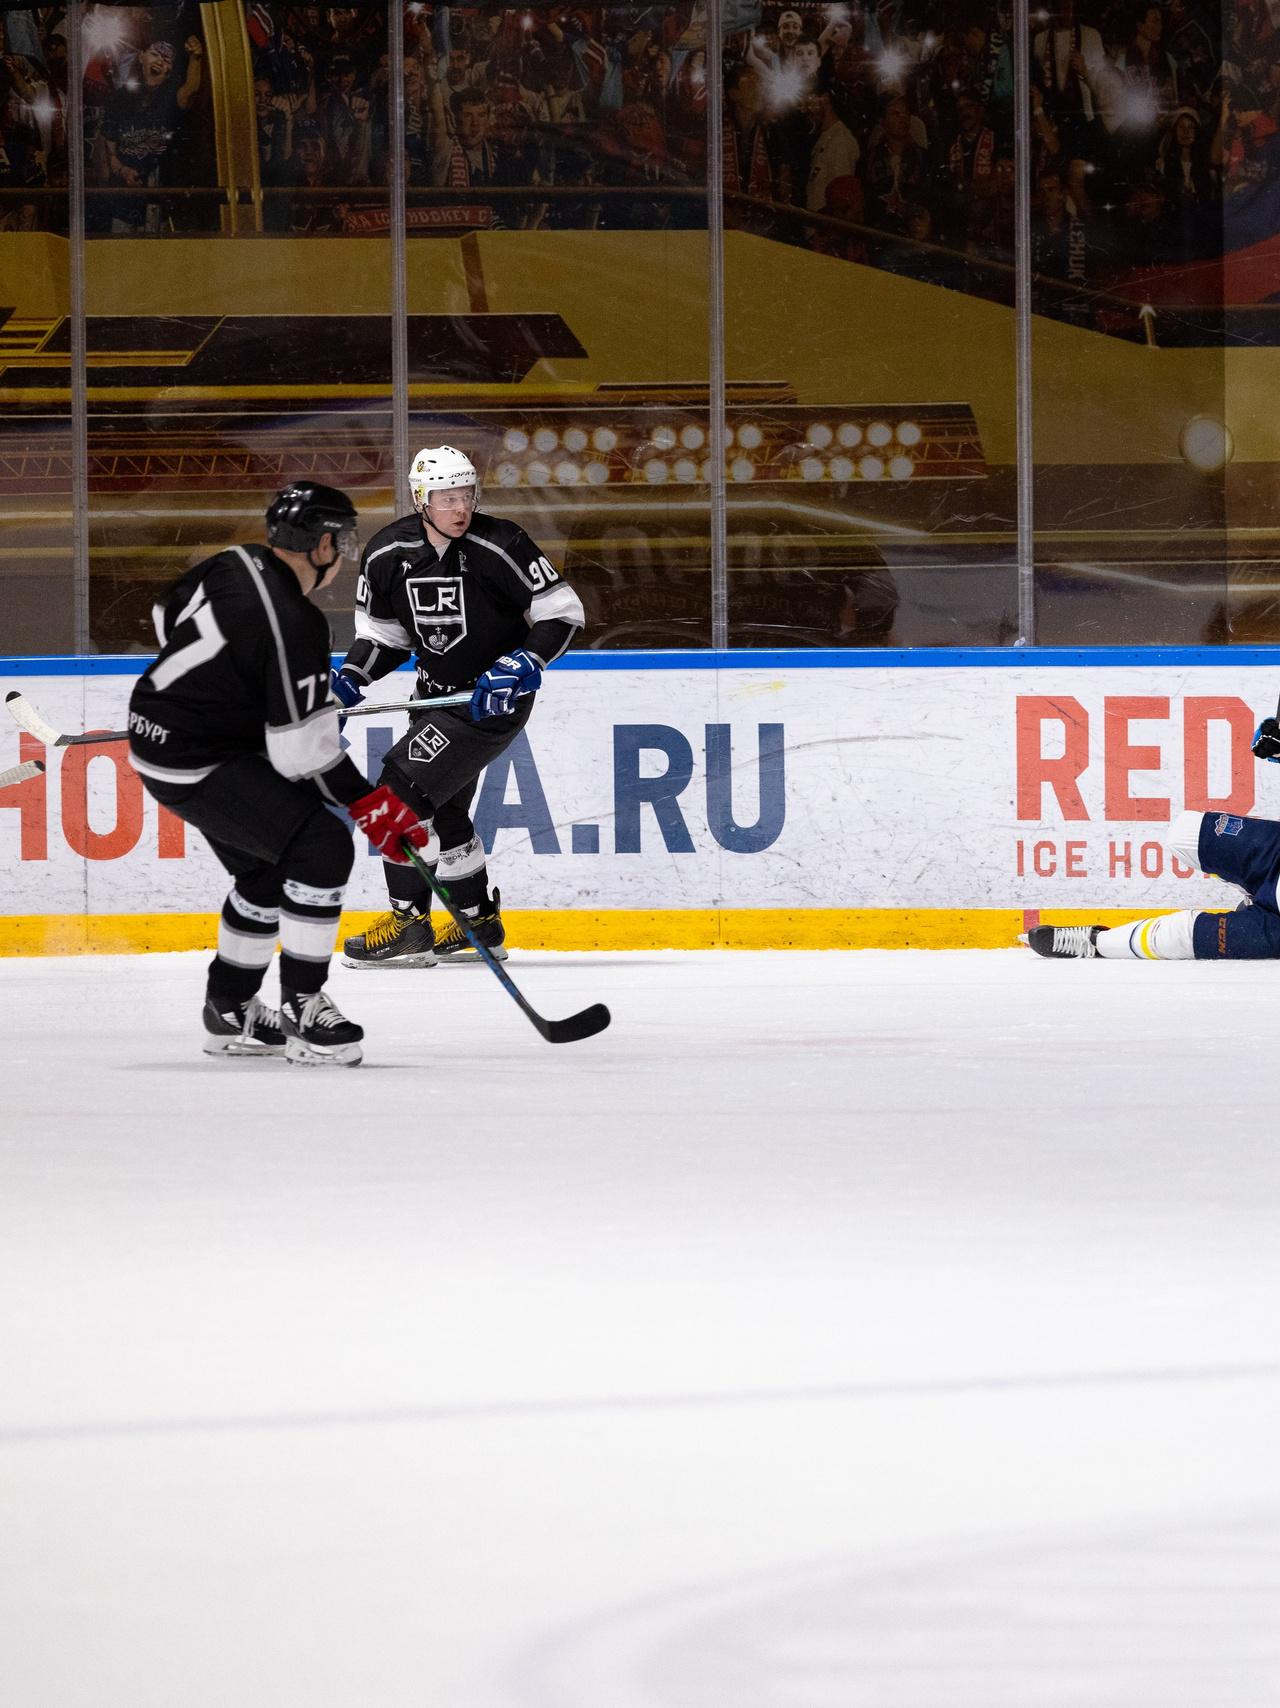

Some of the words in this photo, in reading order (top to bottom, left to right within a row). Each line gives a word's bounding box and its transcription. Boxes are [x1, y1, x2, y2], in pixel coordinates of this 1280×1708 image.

[449, 471, 470, 479] JOFA
[528, 556, 559, 592] 90
[411, 586, 460, 612] LR
[129, 711, 171, 745] РБУРГ
[421, 727, 445, 751] LR
[1016, 696, 1255, 822] RED
[1016, 840, 1088, 879] ICE
